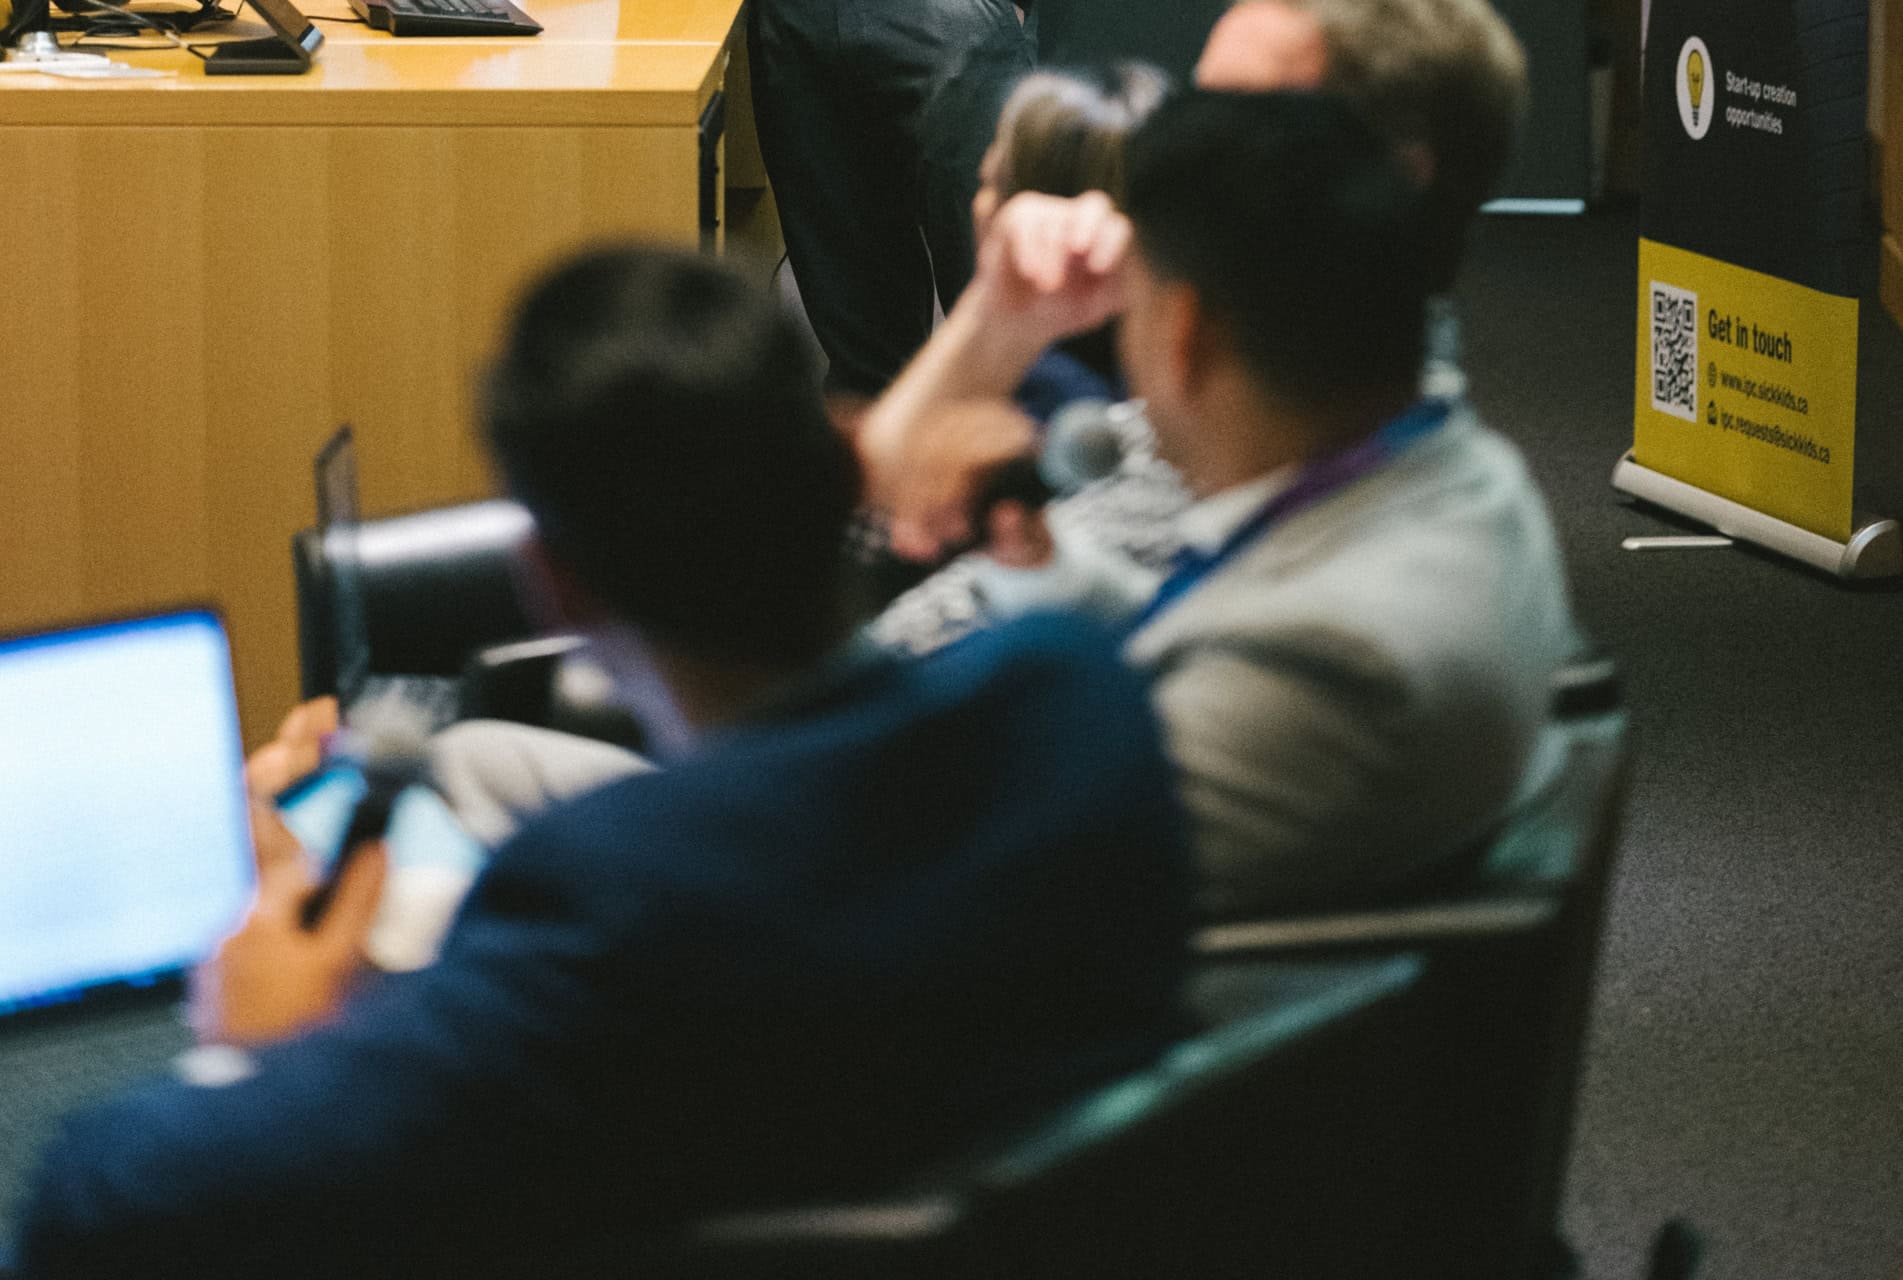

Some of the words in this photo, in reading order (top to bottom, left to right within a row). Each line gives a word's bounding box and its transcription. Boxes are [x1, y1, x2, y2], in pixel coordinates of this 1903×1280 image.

[1726, 70, 1761, 101] Start-up
[1762, 83, 1797, 106] creation
[1726, 107, 1783, 135] opportunities
[1708, 308, 1732, 345] Get
[1736, 316, 1748, 349] in
[1752, 324, 1793, 364] touch
